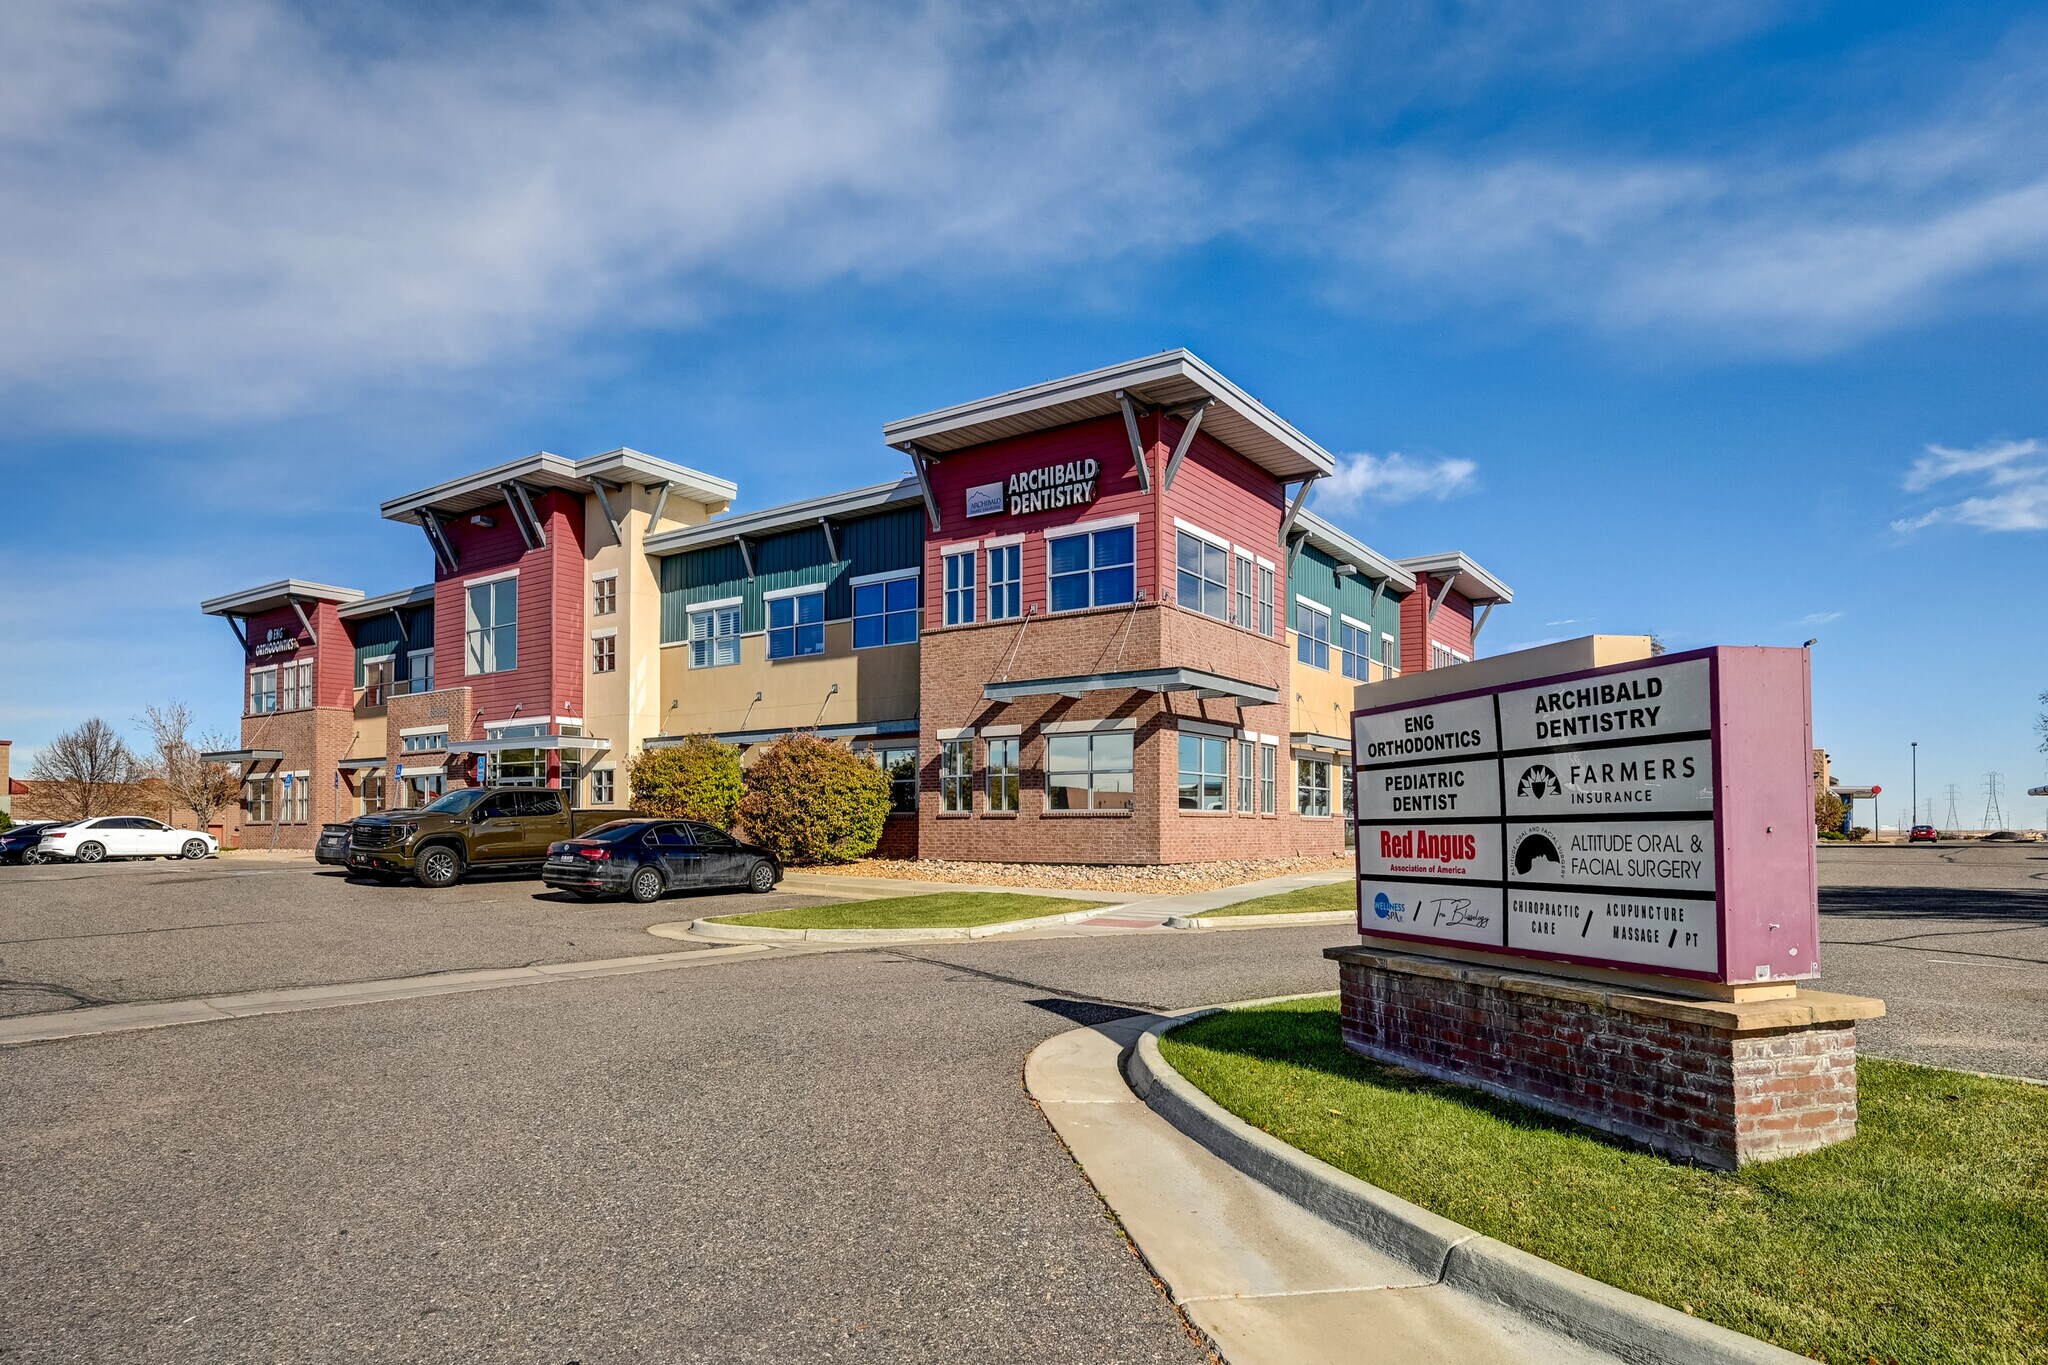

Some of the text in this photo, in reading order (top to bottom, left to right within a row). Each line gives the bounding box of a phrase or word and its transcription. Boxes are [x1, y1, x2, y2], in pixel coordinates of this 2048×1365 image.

[1008, 458, 1098, 495] ARCHIBALD
[1011, 480, 1093, 516] DENTISTRY
[1535, 677, 1663, 714] ARCHIBALD
[1405, 714, 1434, 733] ENG
[1536, 706, 1661, 739] DENTISTRY
[1368, 730, 1481, 757] ORTHODONTICS
[1570, 756, 1696, 784] FARMERS
[1385, 771, 1464, 791] PEDIATRIC
[1393, 794, 1457, 812] DENTIST
[1571, 790, 1652, 804] INSURANCE
[1380, 830, 1476, 863] Red Angus
[1571, 834, 1704, 853] ALTITUDE ORAL &
[1390, 864, 1466, 874] Association of America
[1571, 858, 1702, 879] FACIAL SURGERY
[1374, 901, 1406, 912] WELLNESS
[1513, 900, 1580, 919] CHIROPRACTIC
[1606, 903, 1684, 922] ACUPUNCTURE
[1531, 921, 1556, 935] CARE
[1613, 925, 1659, 943] MASSAGE
[1686, 932, 1698, 948] PT
